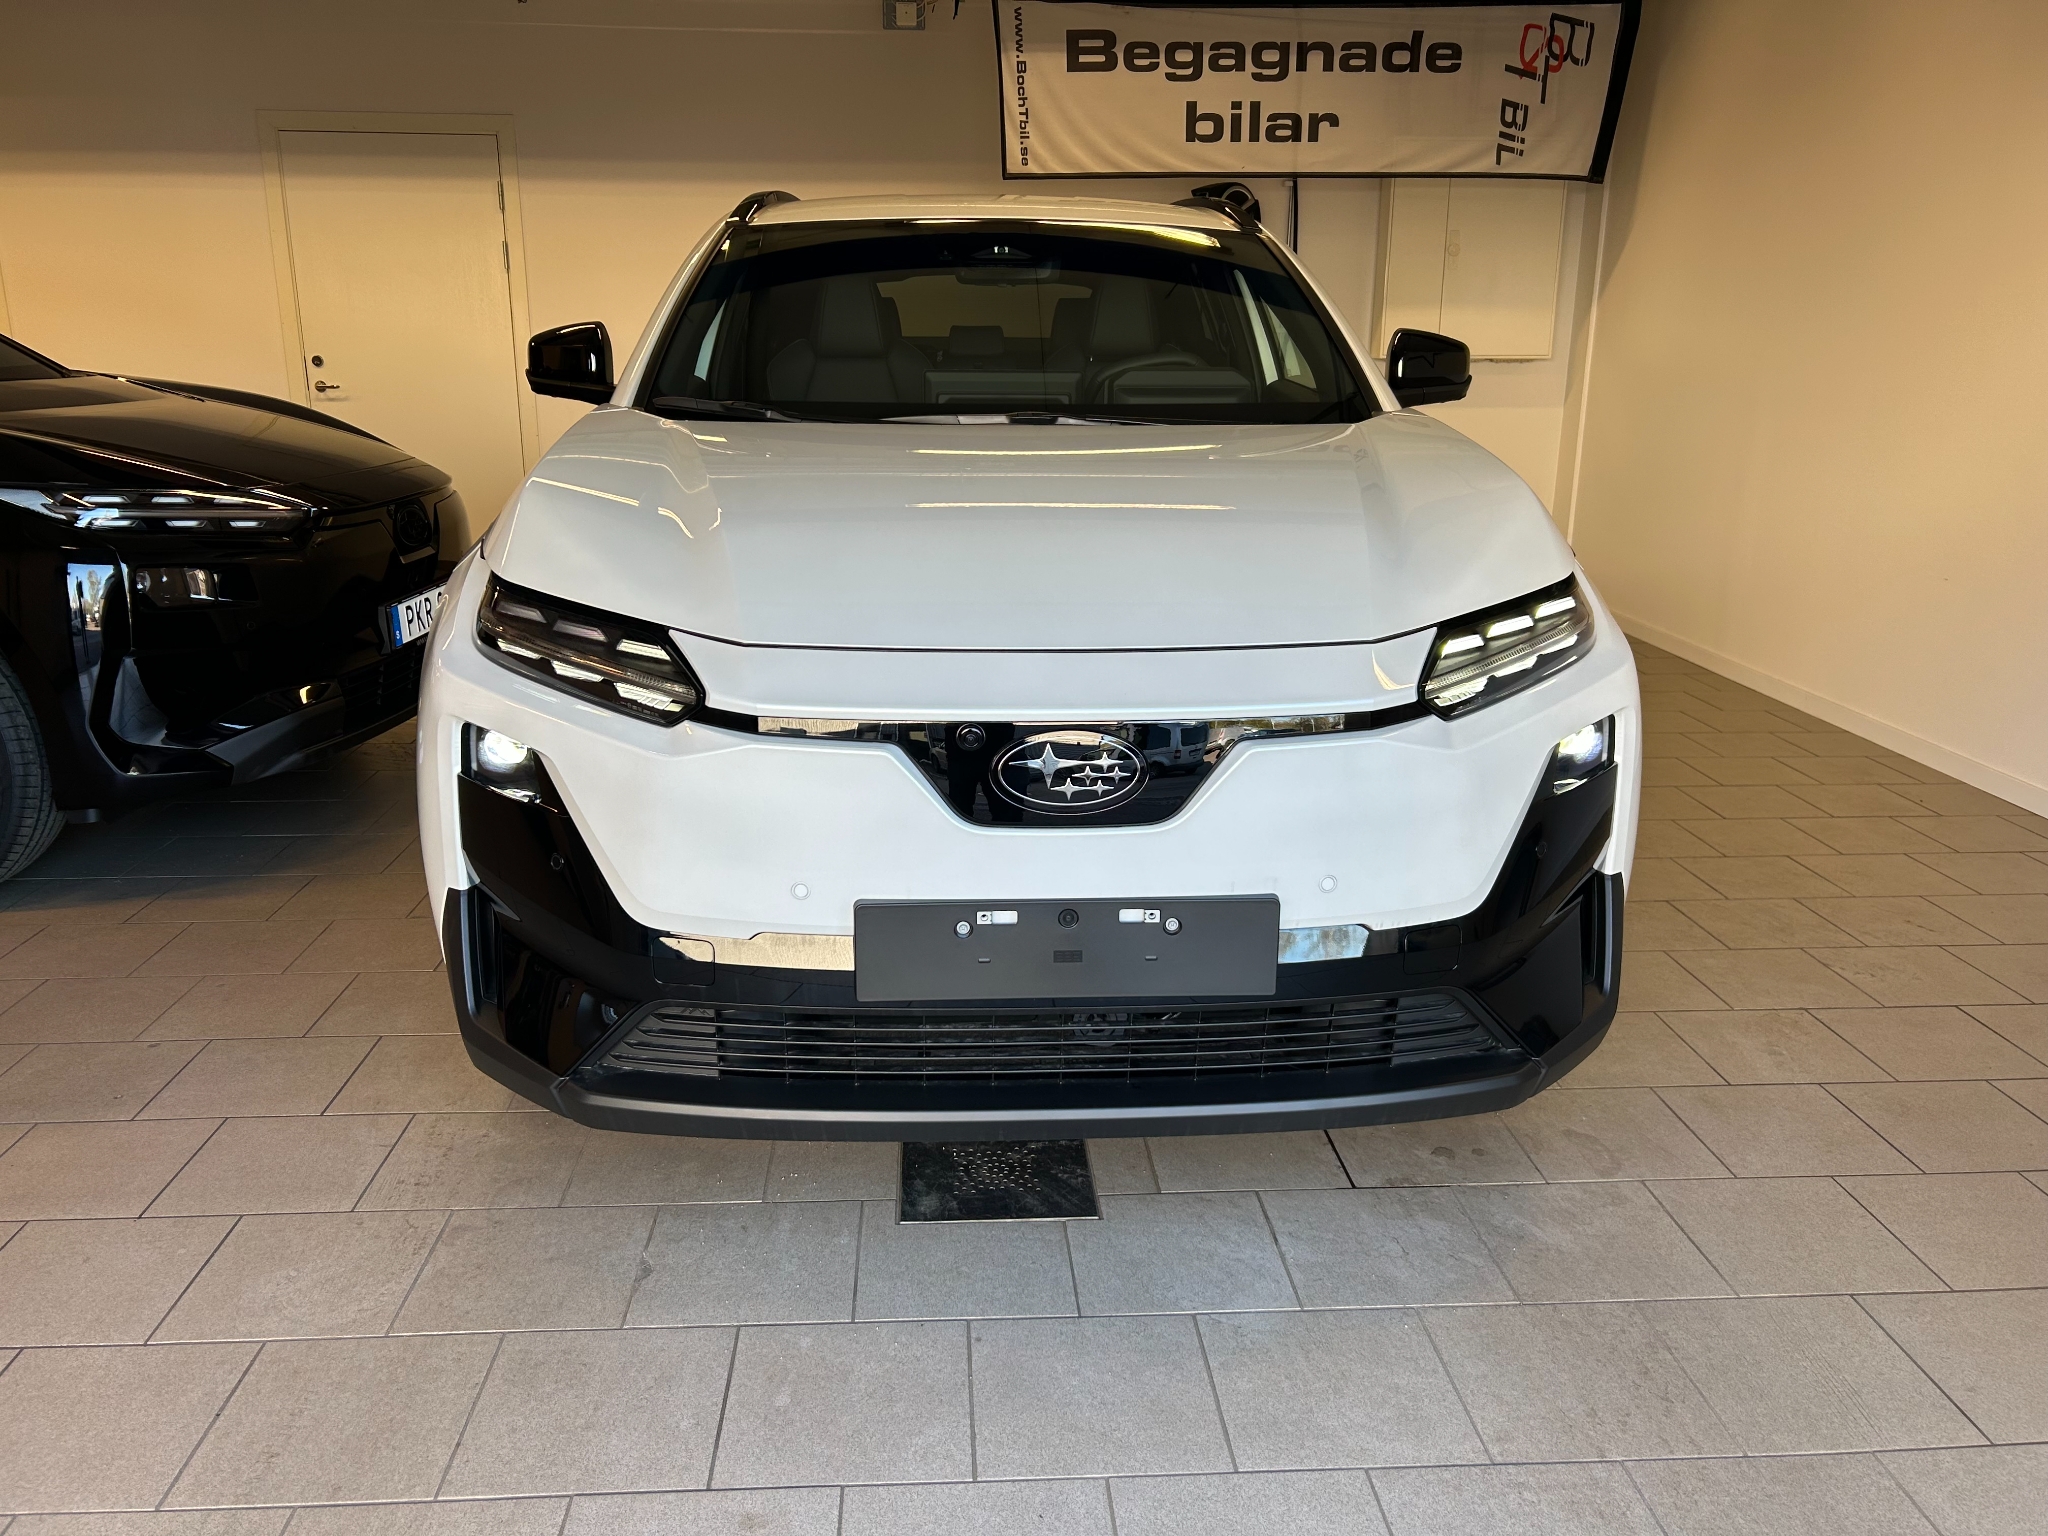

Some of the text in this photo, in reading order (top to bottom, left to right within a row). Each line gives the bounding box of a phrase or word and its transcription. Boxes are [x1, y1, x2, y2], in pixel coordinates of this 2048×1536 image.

[1065, 29, 1463, 82] Begagnade
[1013, 6, 1030, 167] www.BochTbil.se
[1185, 100, 1340, 143] bilar
[405, 596, 433, 637] PKR
